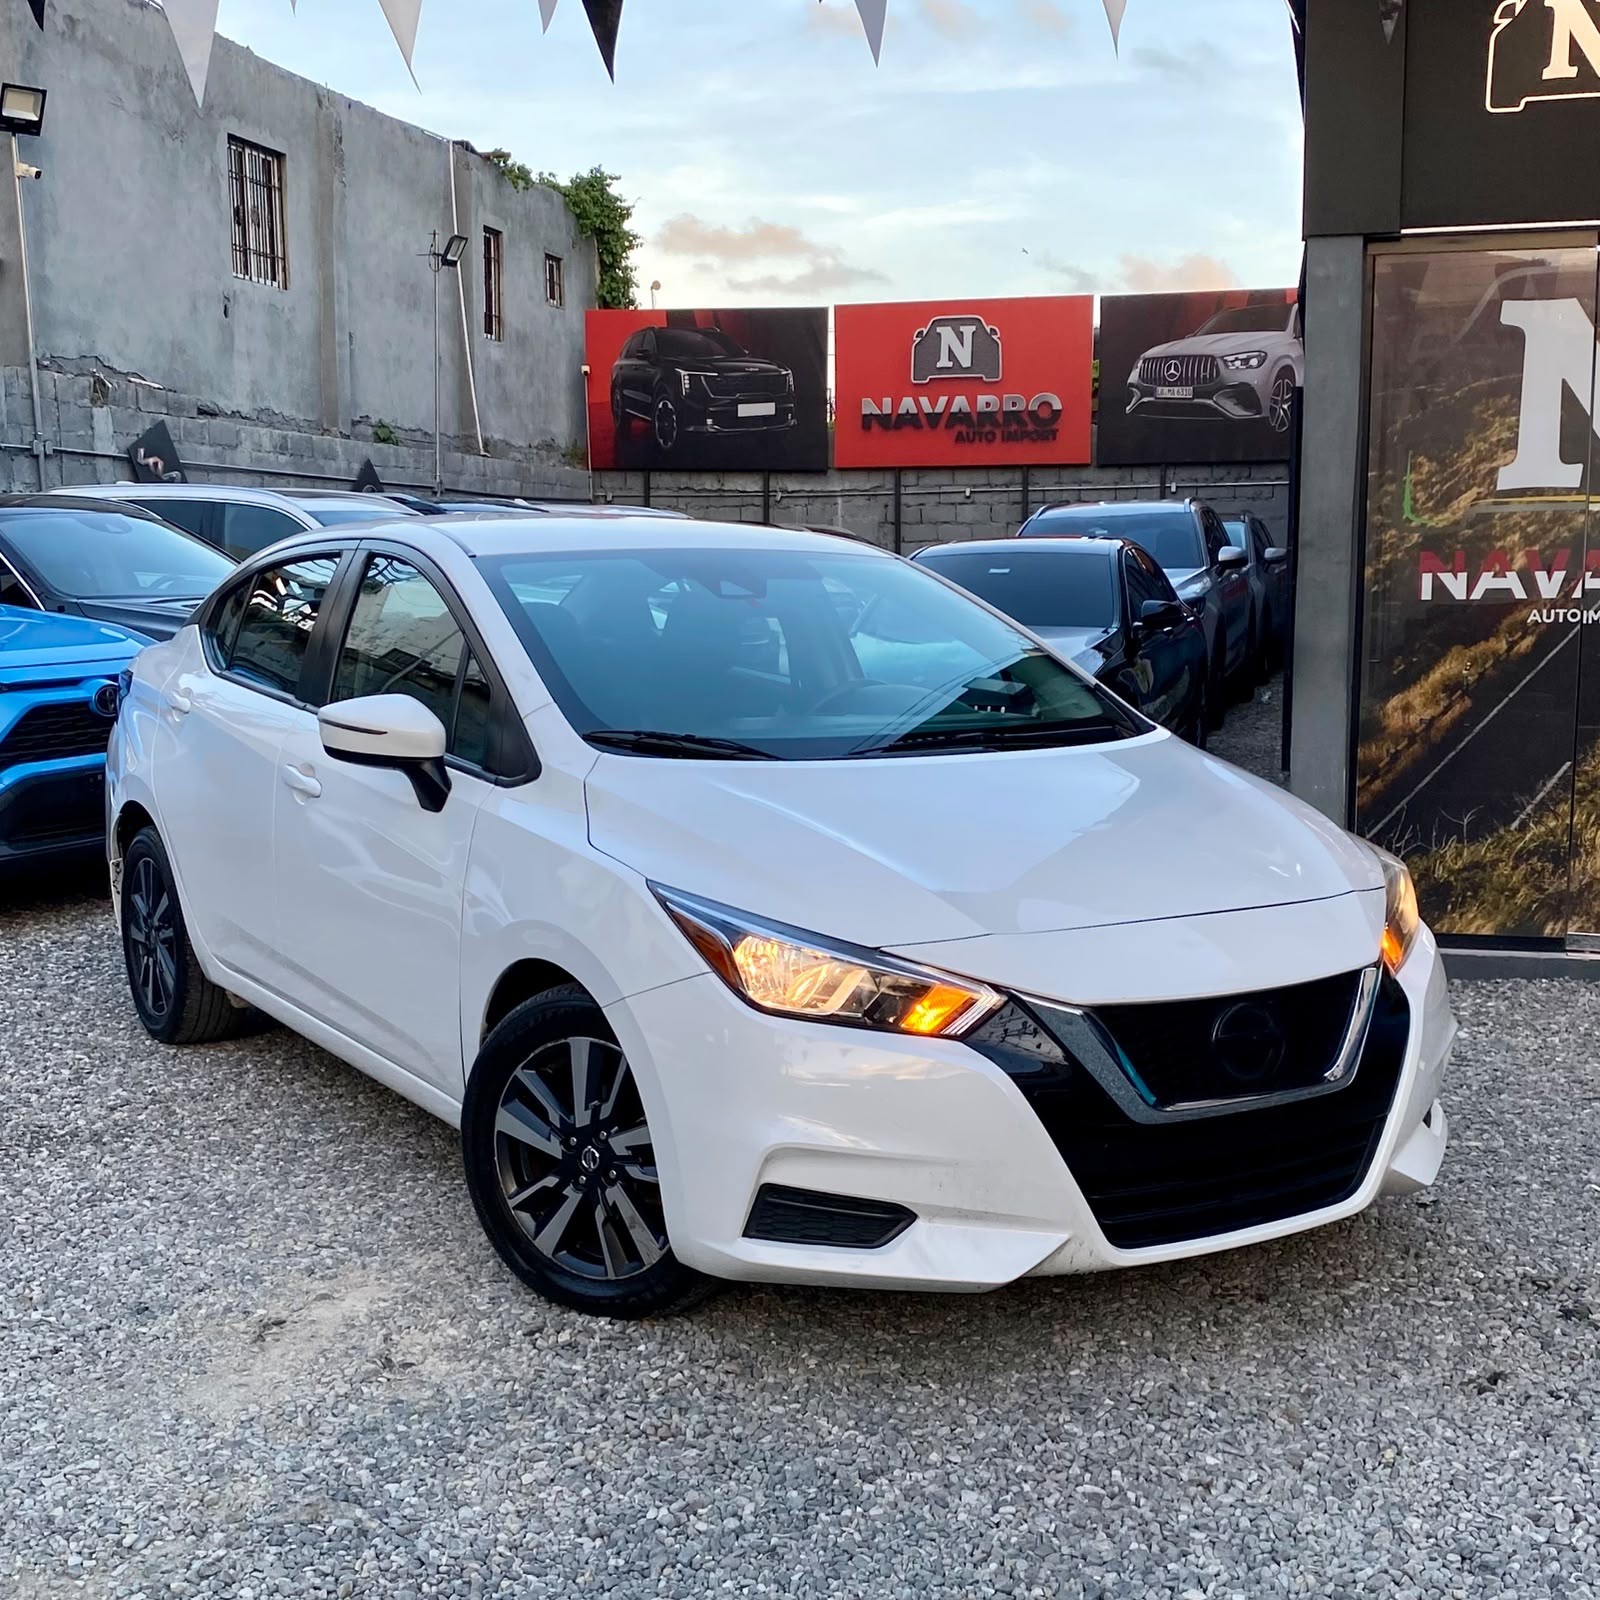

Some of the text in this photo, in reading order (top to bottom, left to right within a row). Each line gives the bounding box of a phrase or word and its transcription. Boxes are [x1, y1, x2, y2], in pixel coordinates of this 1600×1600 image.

[936, 325, 976, 368] N
[861, 392, 1063, 430] NAVARRO
[955, 429, 1060, 444] AUTO IMPORT
